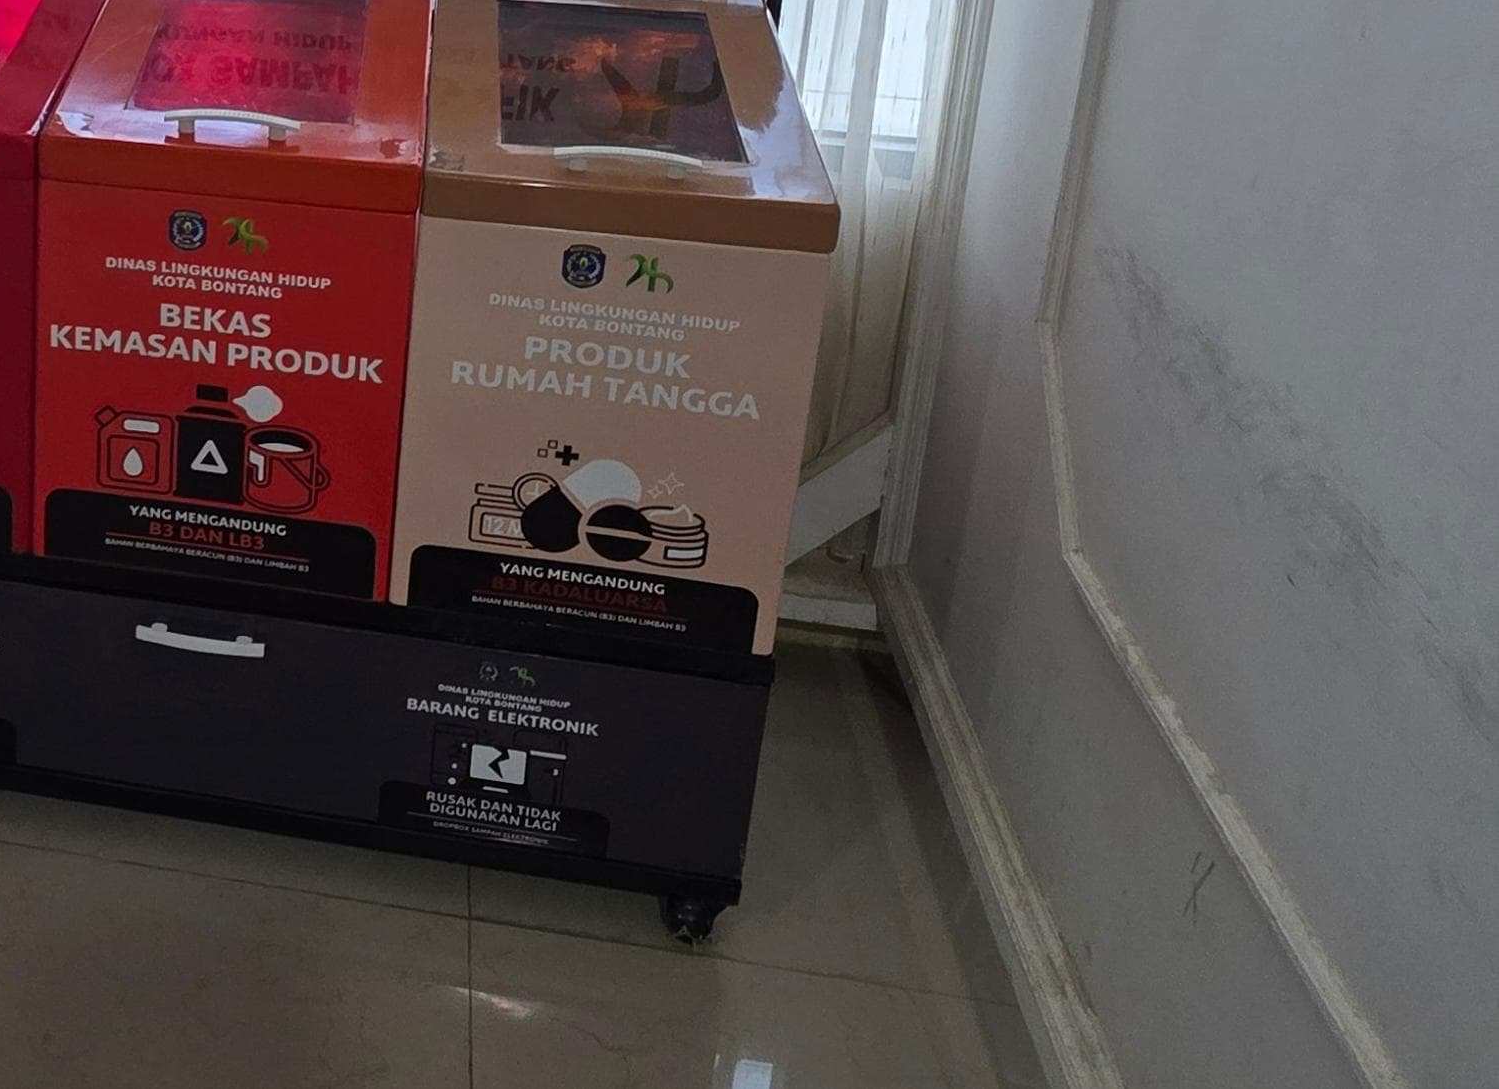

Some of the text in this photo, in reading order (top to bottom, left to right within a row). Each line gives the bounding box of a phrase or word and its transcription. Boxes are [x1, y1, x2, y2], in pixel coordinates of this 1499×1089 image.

[105, 256, 332, 290] DINAS LINGKUNGAN HIDUP
[152, 274, 284, 300] KOTA BONTANG
[159, 302, 272, 339] BEKAS
[488, 292, 741, 333] DINAS LINGKUNGAN HIDUP
[538, 313, 687, 343] KOTA BONTANG
[49, 323, 384, 384] KEMASAN PRODUK
[523, 334, 691, 379] PRODUK
[450, 360, 761, 421] RUMAH TANGGA
[128, 504, 288, 537] YANG MENGANDUNG
[148, 520, 265, 550] B3 DAN LB3
[185, 547, 226, 561] BERACUN
[243, 556, 264, 566] DAN
[499, 561, 666, 595] YANG MENGANDUNG
[471, 595, 502, 606] BAHAN
[502, 598, 555, 613] BERBAHAYA
[555, 606, 598, 619] BERACUN
[617, 614, 638, 625] DAN
[638, 617, 674, 631] LIMBAH
[406, 697, 600, 737] BARANG ELEKTRONIK
[464, 695, 543, 713] KOTA BONTANG
[539, 697, 571, 709] HIDUP
[425, 790, 561, 822] RUSAK DAN TIDAK
[429, 802, 557, 832] DIGUNAKAN LAGI
